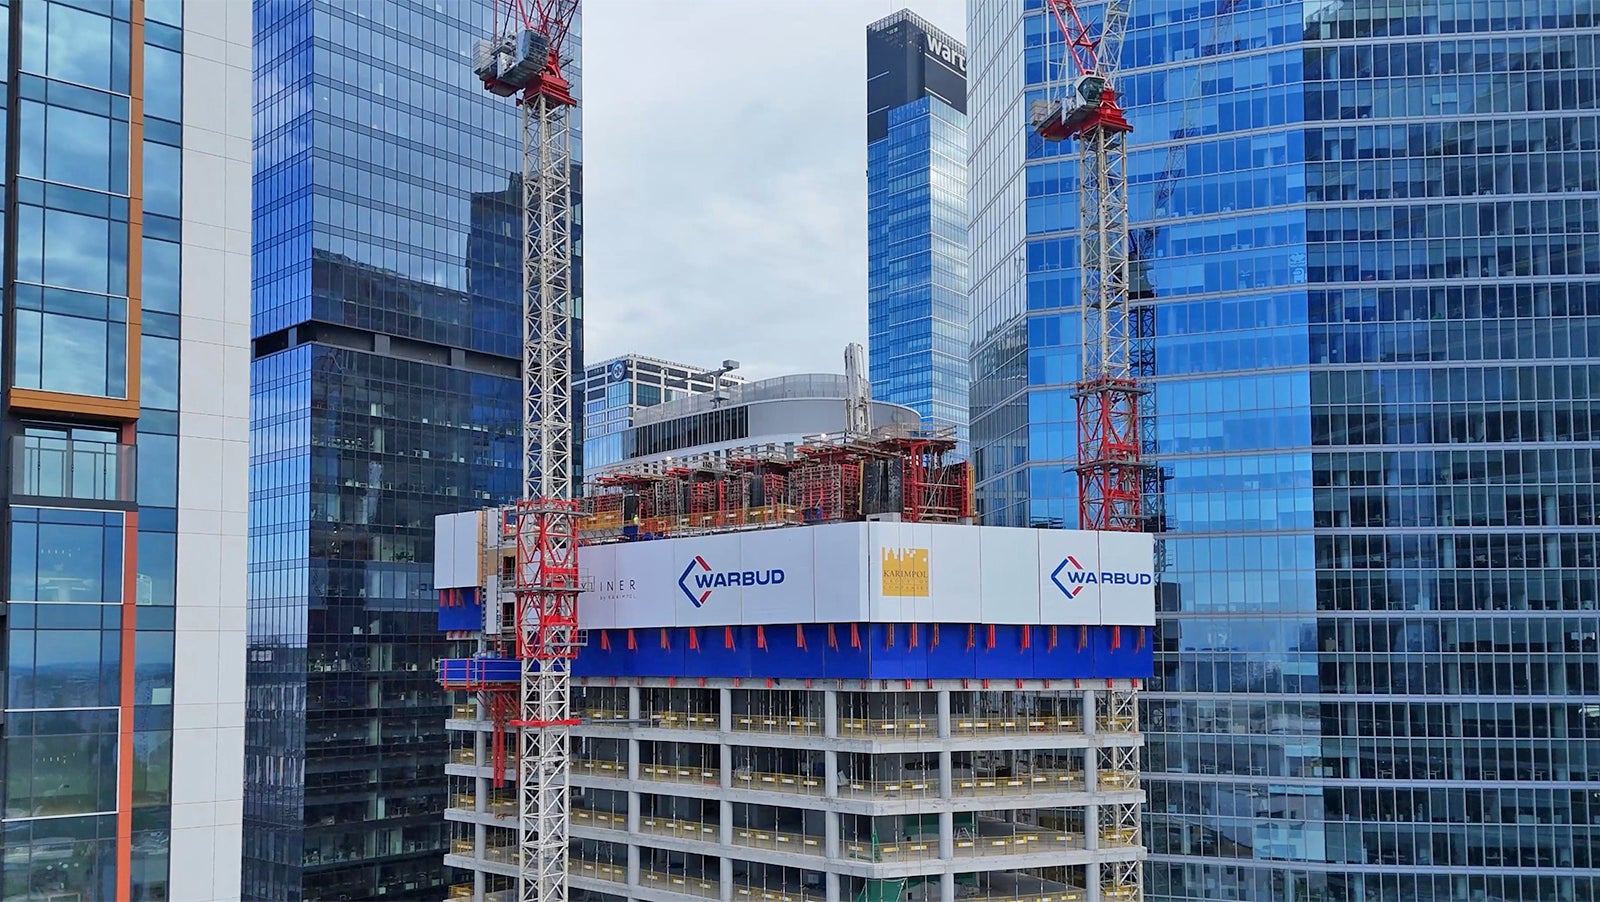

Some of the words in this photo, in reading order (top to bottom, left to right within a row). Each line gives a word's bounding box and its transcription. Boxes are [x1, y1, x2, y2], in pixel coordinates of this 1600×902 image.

[695, 569, 785, 588] WARBUD
[883, 569, 928, 578] KARIMPOL
[1067, 571, 1152, 585] WARBUD
